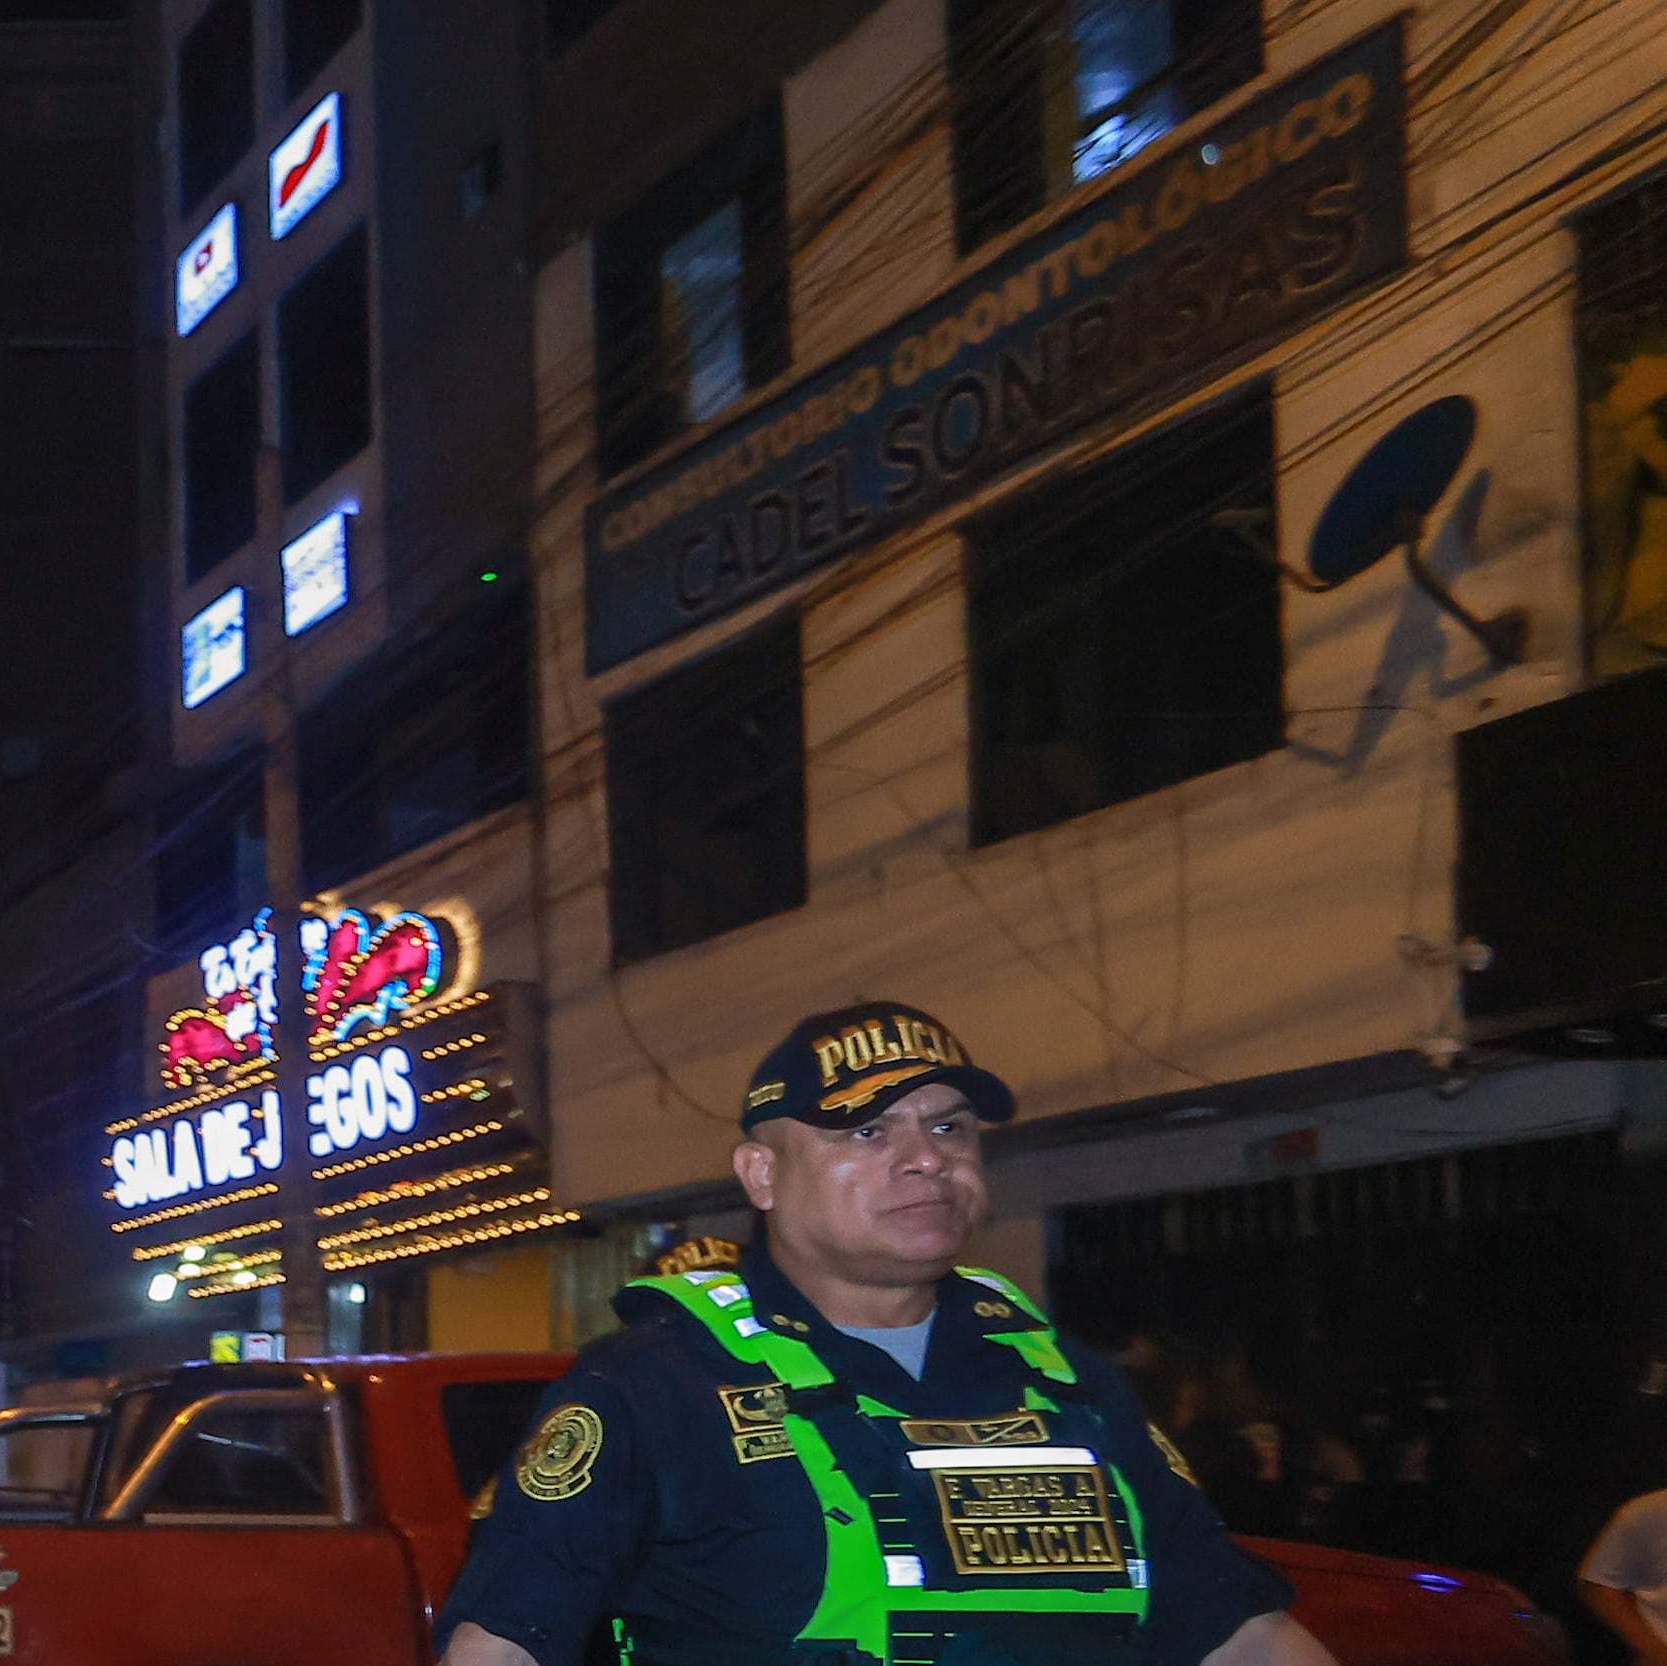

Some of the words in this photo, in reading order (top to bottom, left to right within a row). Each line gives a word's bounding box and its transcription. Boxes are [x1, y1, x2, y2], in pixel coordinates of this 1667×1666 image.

[884, 179, 1365, 509] SONRISAS
[113, 1120, 204, 1209] SALA
[201, 1100, 257, 1185] DE
[254, 1046, 417, 1169] JEGOS
[956, 1523, 1114, 1565] POLICIA
